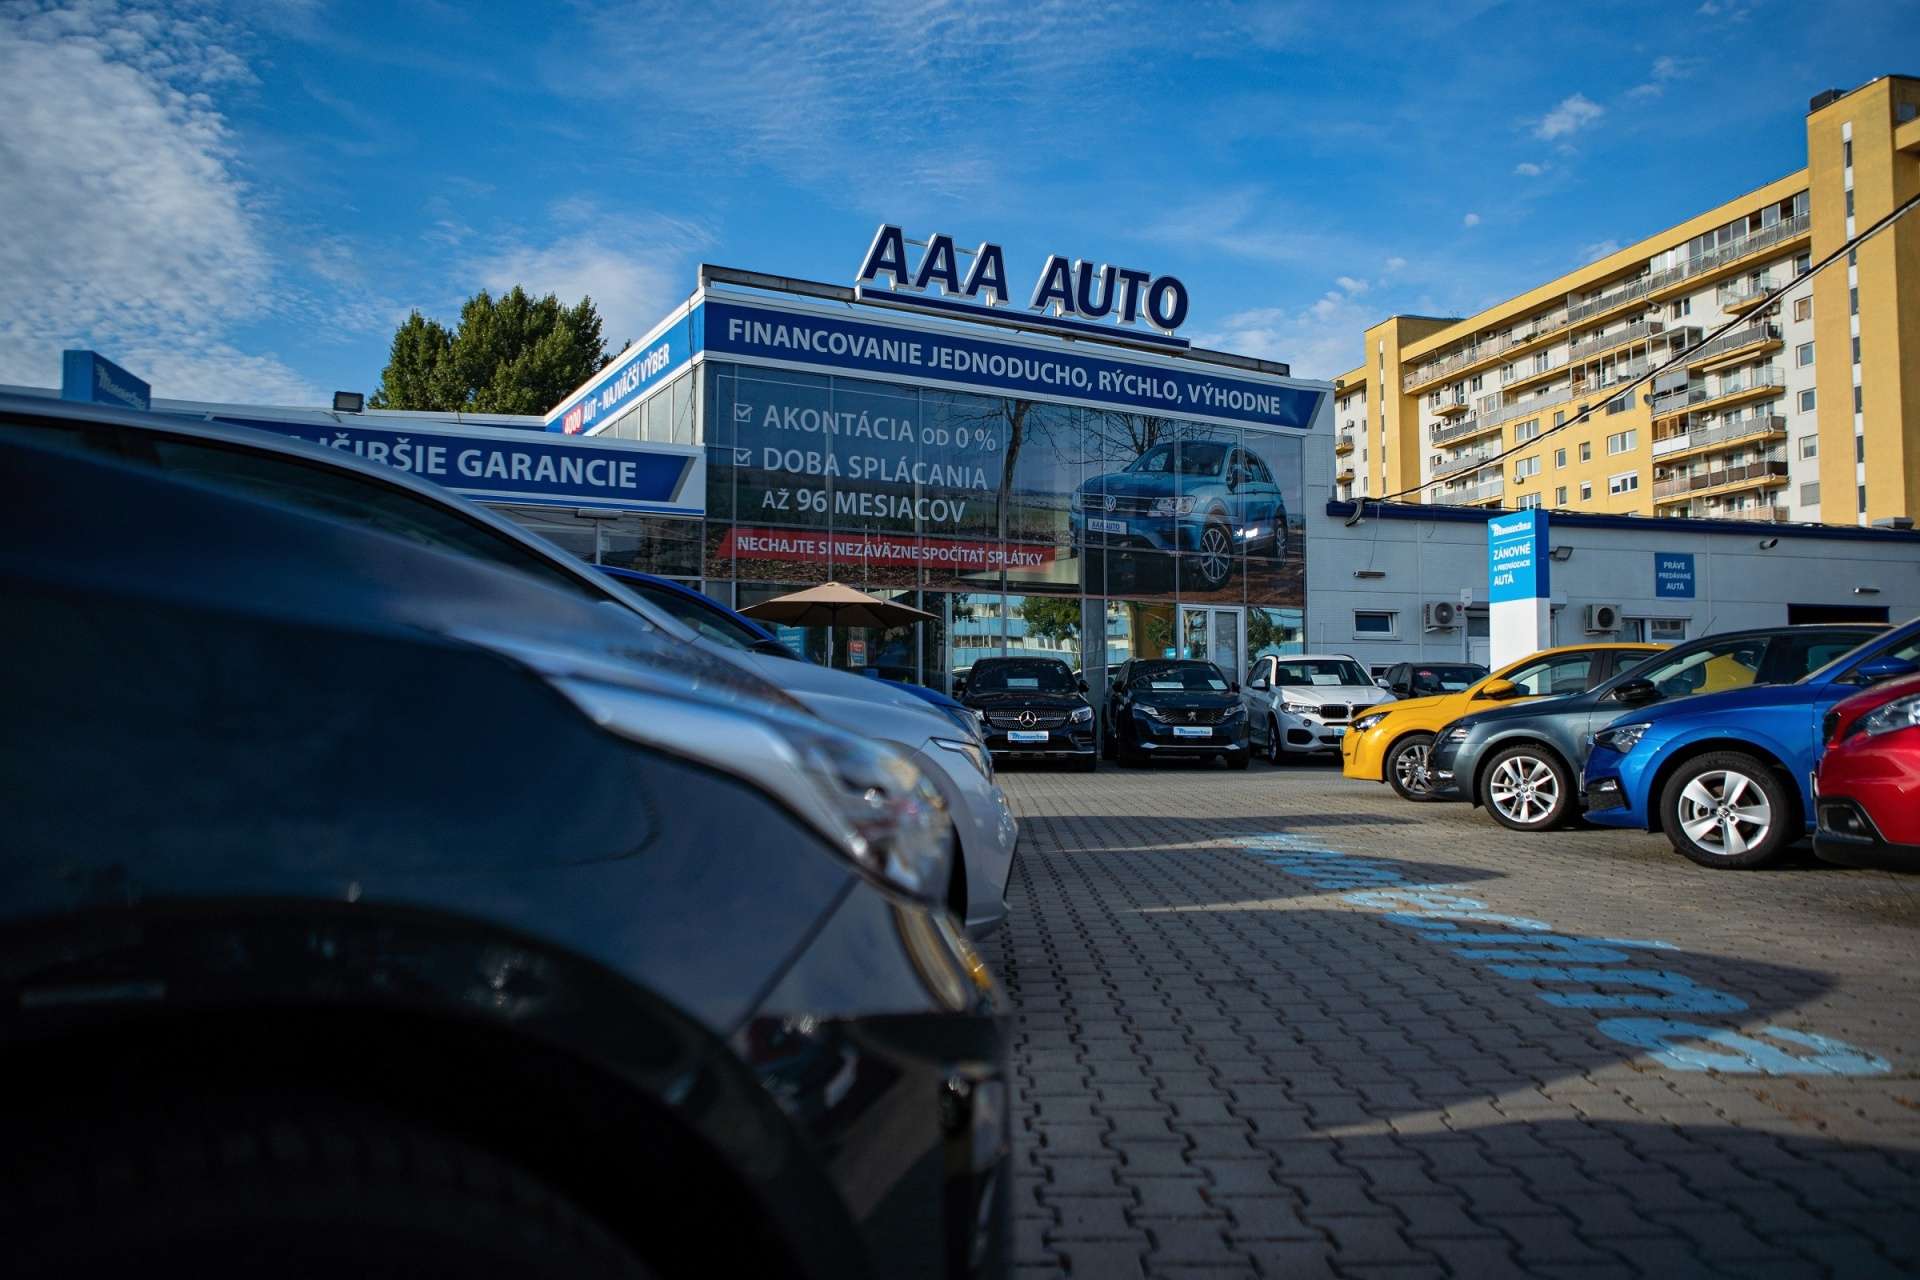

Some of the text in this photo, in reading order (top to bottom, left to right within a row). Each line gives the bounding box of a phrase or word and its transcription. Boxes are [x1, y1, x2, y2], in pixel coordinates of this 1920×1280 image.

[855, 223, 1189, 334] AAA AUTO
[728, 318, 1281, 416] FINANCOVANIE JEDNODUCHO, RÝCHLO, VÝHODNE
[763, 404, 996, 451] AKONTÁCIA OD 0 %
[457, 449, 638, 489] GARANCIE
[763, 447, 989, 490] DOBA SPLÁCANIA
[761, 487, 966, 523] AŽ 96 MESIACOV
[737, 536, 1043, 566] NECHAJTE SI NEZÁVÄZNE SPOČÍTAŤ SPLÁTKY
[1493, 542, 1531, 561] ZÁNOVNÉ
[1663, 560, 1686, 570] PRÁVE
[1493, 570, 1514, 586] AUTÁ
